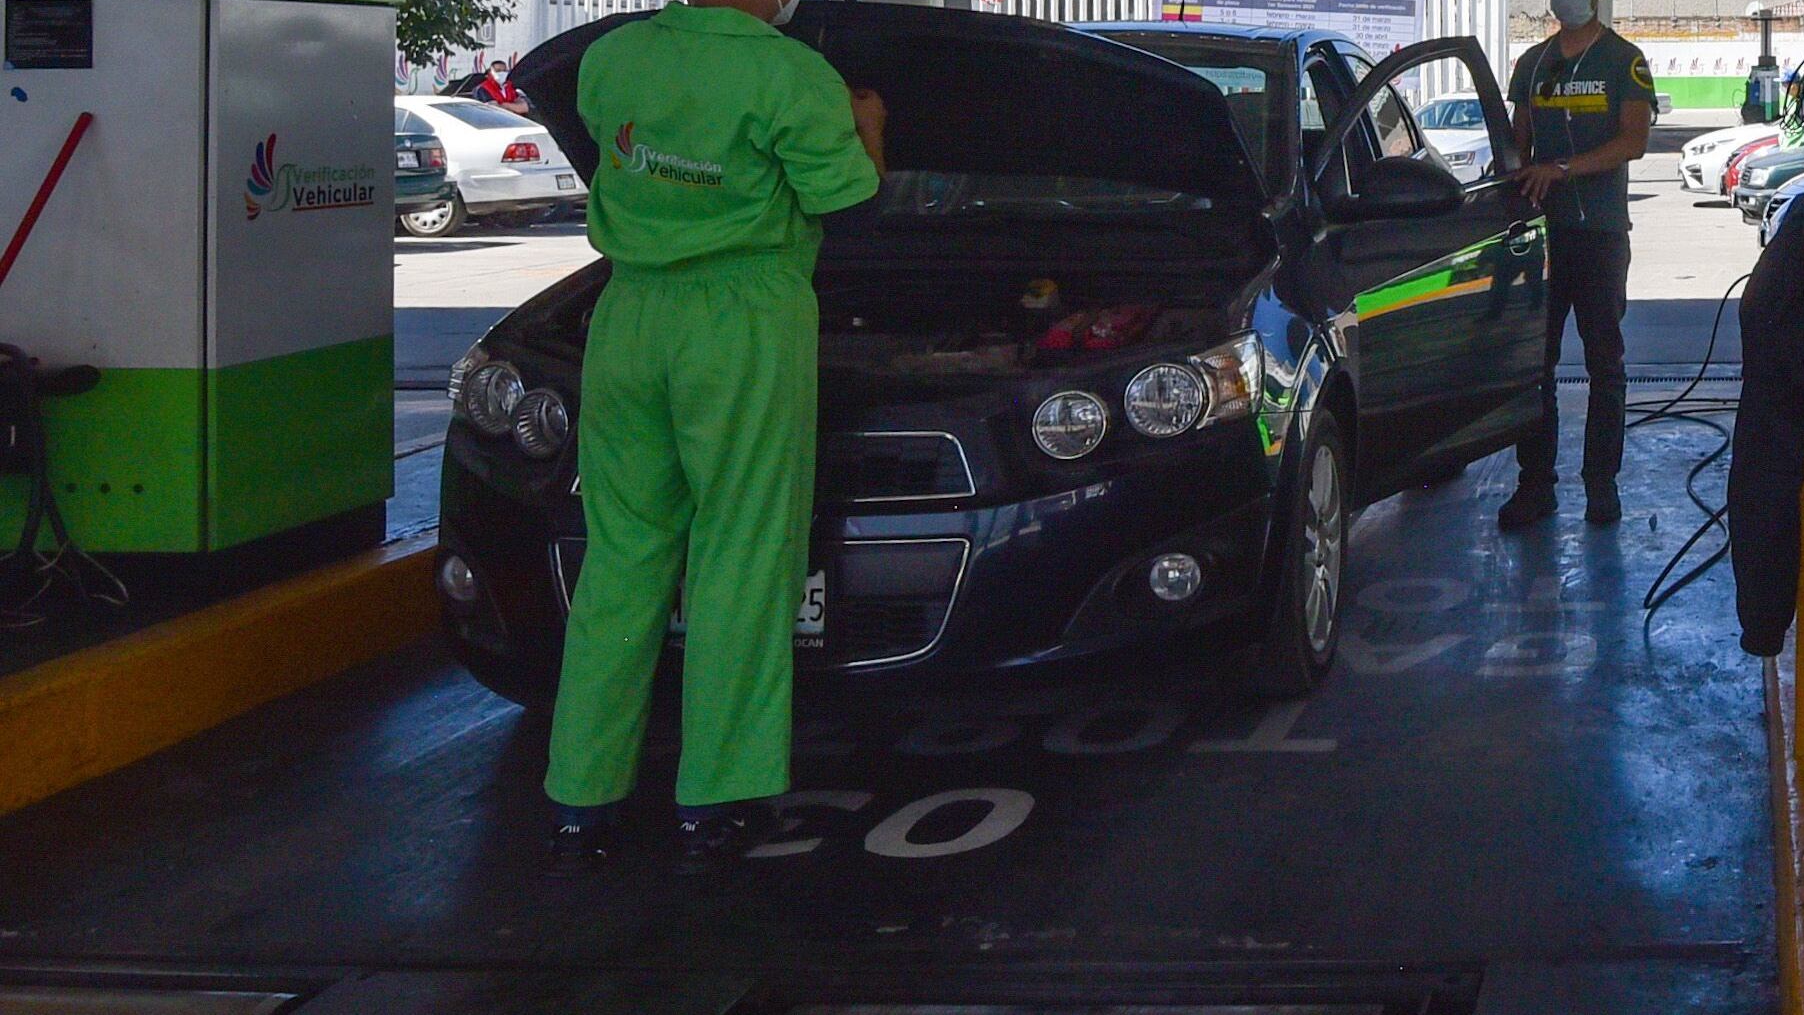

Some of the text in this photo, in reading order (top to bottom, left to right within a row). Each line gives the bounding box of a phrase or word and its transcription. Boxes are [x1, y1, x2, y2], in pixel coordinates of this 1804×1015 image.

[1563, 80, 1606, 96] SERVICE
[293, 164, 375, 184] Verificación
[645, 160, 724, 186] Vehicular
[293, 183, 375, 206] Vehicular
